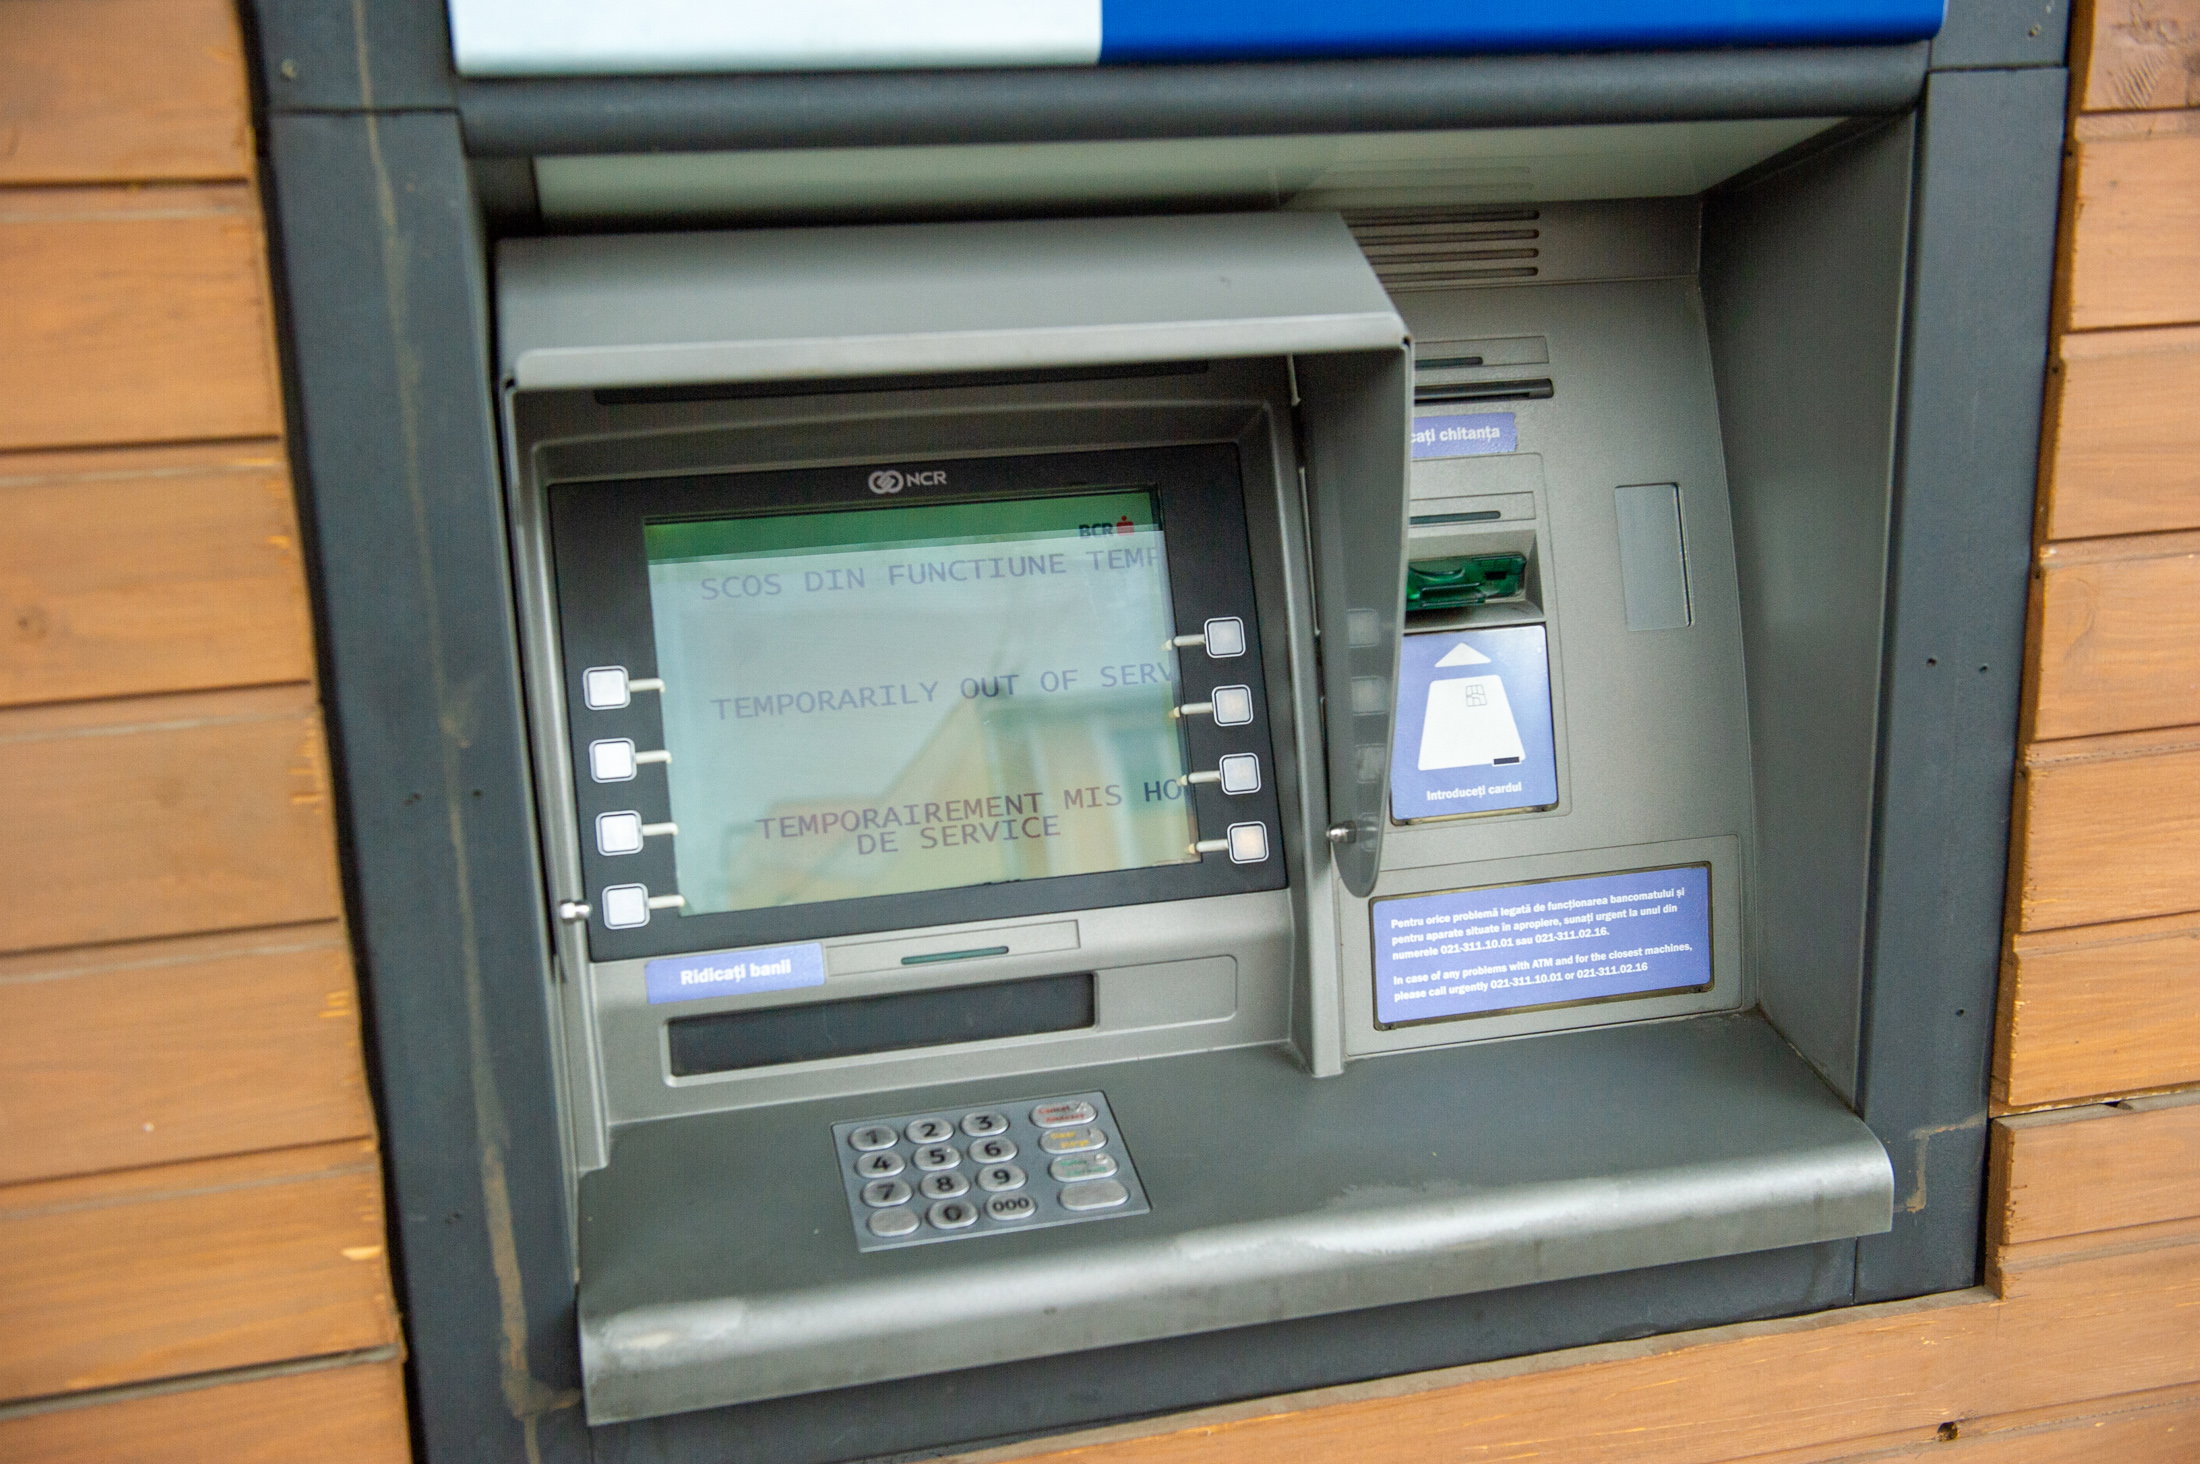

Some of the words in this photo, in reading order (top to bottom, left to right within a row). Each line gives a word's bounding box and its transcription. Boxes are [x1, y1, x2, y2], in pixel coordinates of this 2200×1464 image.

[1439, 426, 1500, 442] chitanța
[906, 471, 947, 487] NCR
[1079, 522, 1113, 537] BCR
[701, 573, 782, 601] SCOS
[804, 567, 865, 592] DIN
[888, 553, 1067, 586] FUNCTIUNE
[710, 681, 939, 721] TEMPORARILY
[960, 674, 1019, 700] OUT
[1040, 669, 1078, 693] OF
[1426, 784, 1486, 800] Introduceți
[1488, 781, 1522, 795] cardul
[755, 792, 1043, 839] TEMPORAIREMENT
[1063, 784, 1122, 810] MIS
[857, 831, 899, 855] DE
[920, 815, 1061, 850] SERVICE
[1391, 918, 1424, 929] Pentru
[1426, 915, 1451, 926] orice
[1453, 907, 1499, 923] problemă
[1500, 903, 1532, 918] legată
[1533, 902, 1546, 912] de
[1547, 897, 1608, 911] funcționarea
[1610, 888, 1675, 904] bancomatului
[1676, 887, 1685, 899] și
[1391, 933, 1424, 947] pentru
[1426, 928, 1464, 942] aparate
[1465, 924, 1500, 936] situate
[1513, 914, 1562, 932] apropiere,
[1564, 911, 1594, 925] sunați
[1596, 908, 1628, 922] urgent
[1628, 908, 1638, 917] la
[1640, 905, 1661, 916] unul
[1663, 903, 1678, 914] din
[1392, 946, 1439, 961] numerele
[1440, 938, 1514, 955] 021-311.10.01
[1515, 936, 1533, 947] sau
[1535, 927, 1610, 944] 021-311.02.16.
[680, 964, 747, 985] Ridicați
[749, 959, 792, 977] banii
[1393, 975, 1404, 985] In
[1405, 973, 1429, 984] case
[1430, 970, 1441, 981] of
[1442, 969, 1461, 981] any
[1462, 963, 1508, 979] problems
[1509, 960, 1531, 972] with
[1532, 956, 1553, 969] ATM
[1555, 954, 1574, 966] and
[1575, 953, 1589, 964] for
[1591, 950, 1607, 962] the
[1608, 947, 1643, 960] closest
[1644, 942, 1693, 957] machines,
[1394, 987, 1427, 1002] please
[1428, 985, 1447, 997] call
[1448, 981, 1488, 996] urgently
[1490, 972, 1563, 990] 021-311.10.01
[1564, 971, 1575, 981] or
[1576, 961, 1649, 979] 021-311.02.16
[921, 1122, 939, 1138] 2
[975, 1115, 992, 1131] 3
[865, 1129, 878, 1145] 1
[929, 1149, 946, 1165] 5
[983, 1141, 1001, 1157] 6
[872, 1156, 891, 1171] 4
[935, 1176, 954, 1193] 8
[993, 1169, 1010, 1185] 9
[877, 1183, 895, 1201] 7
[943, 1204, 962, 1222] 0
[992, 1197, 1029, 1212] 000
